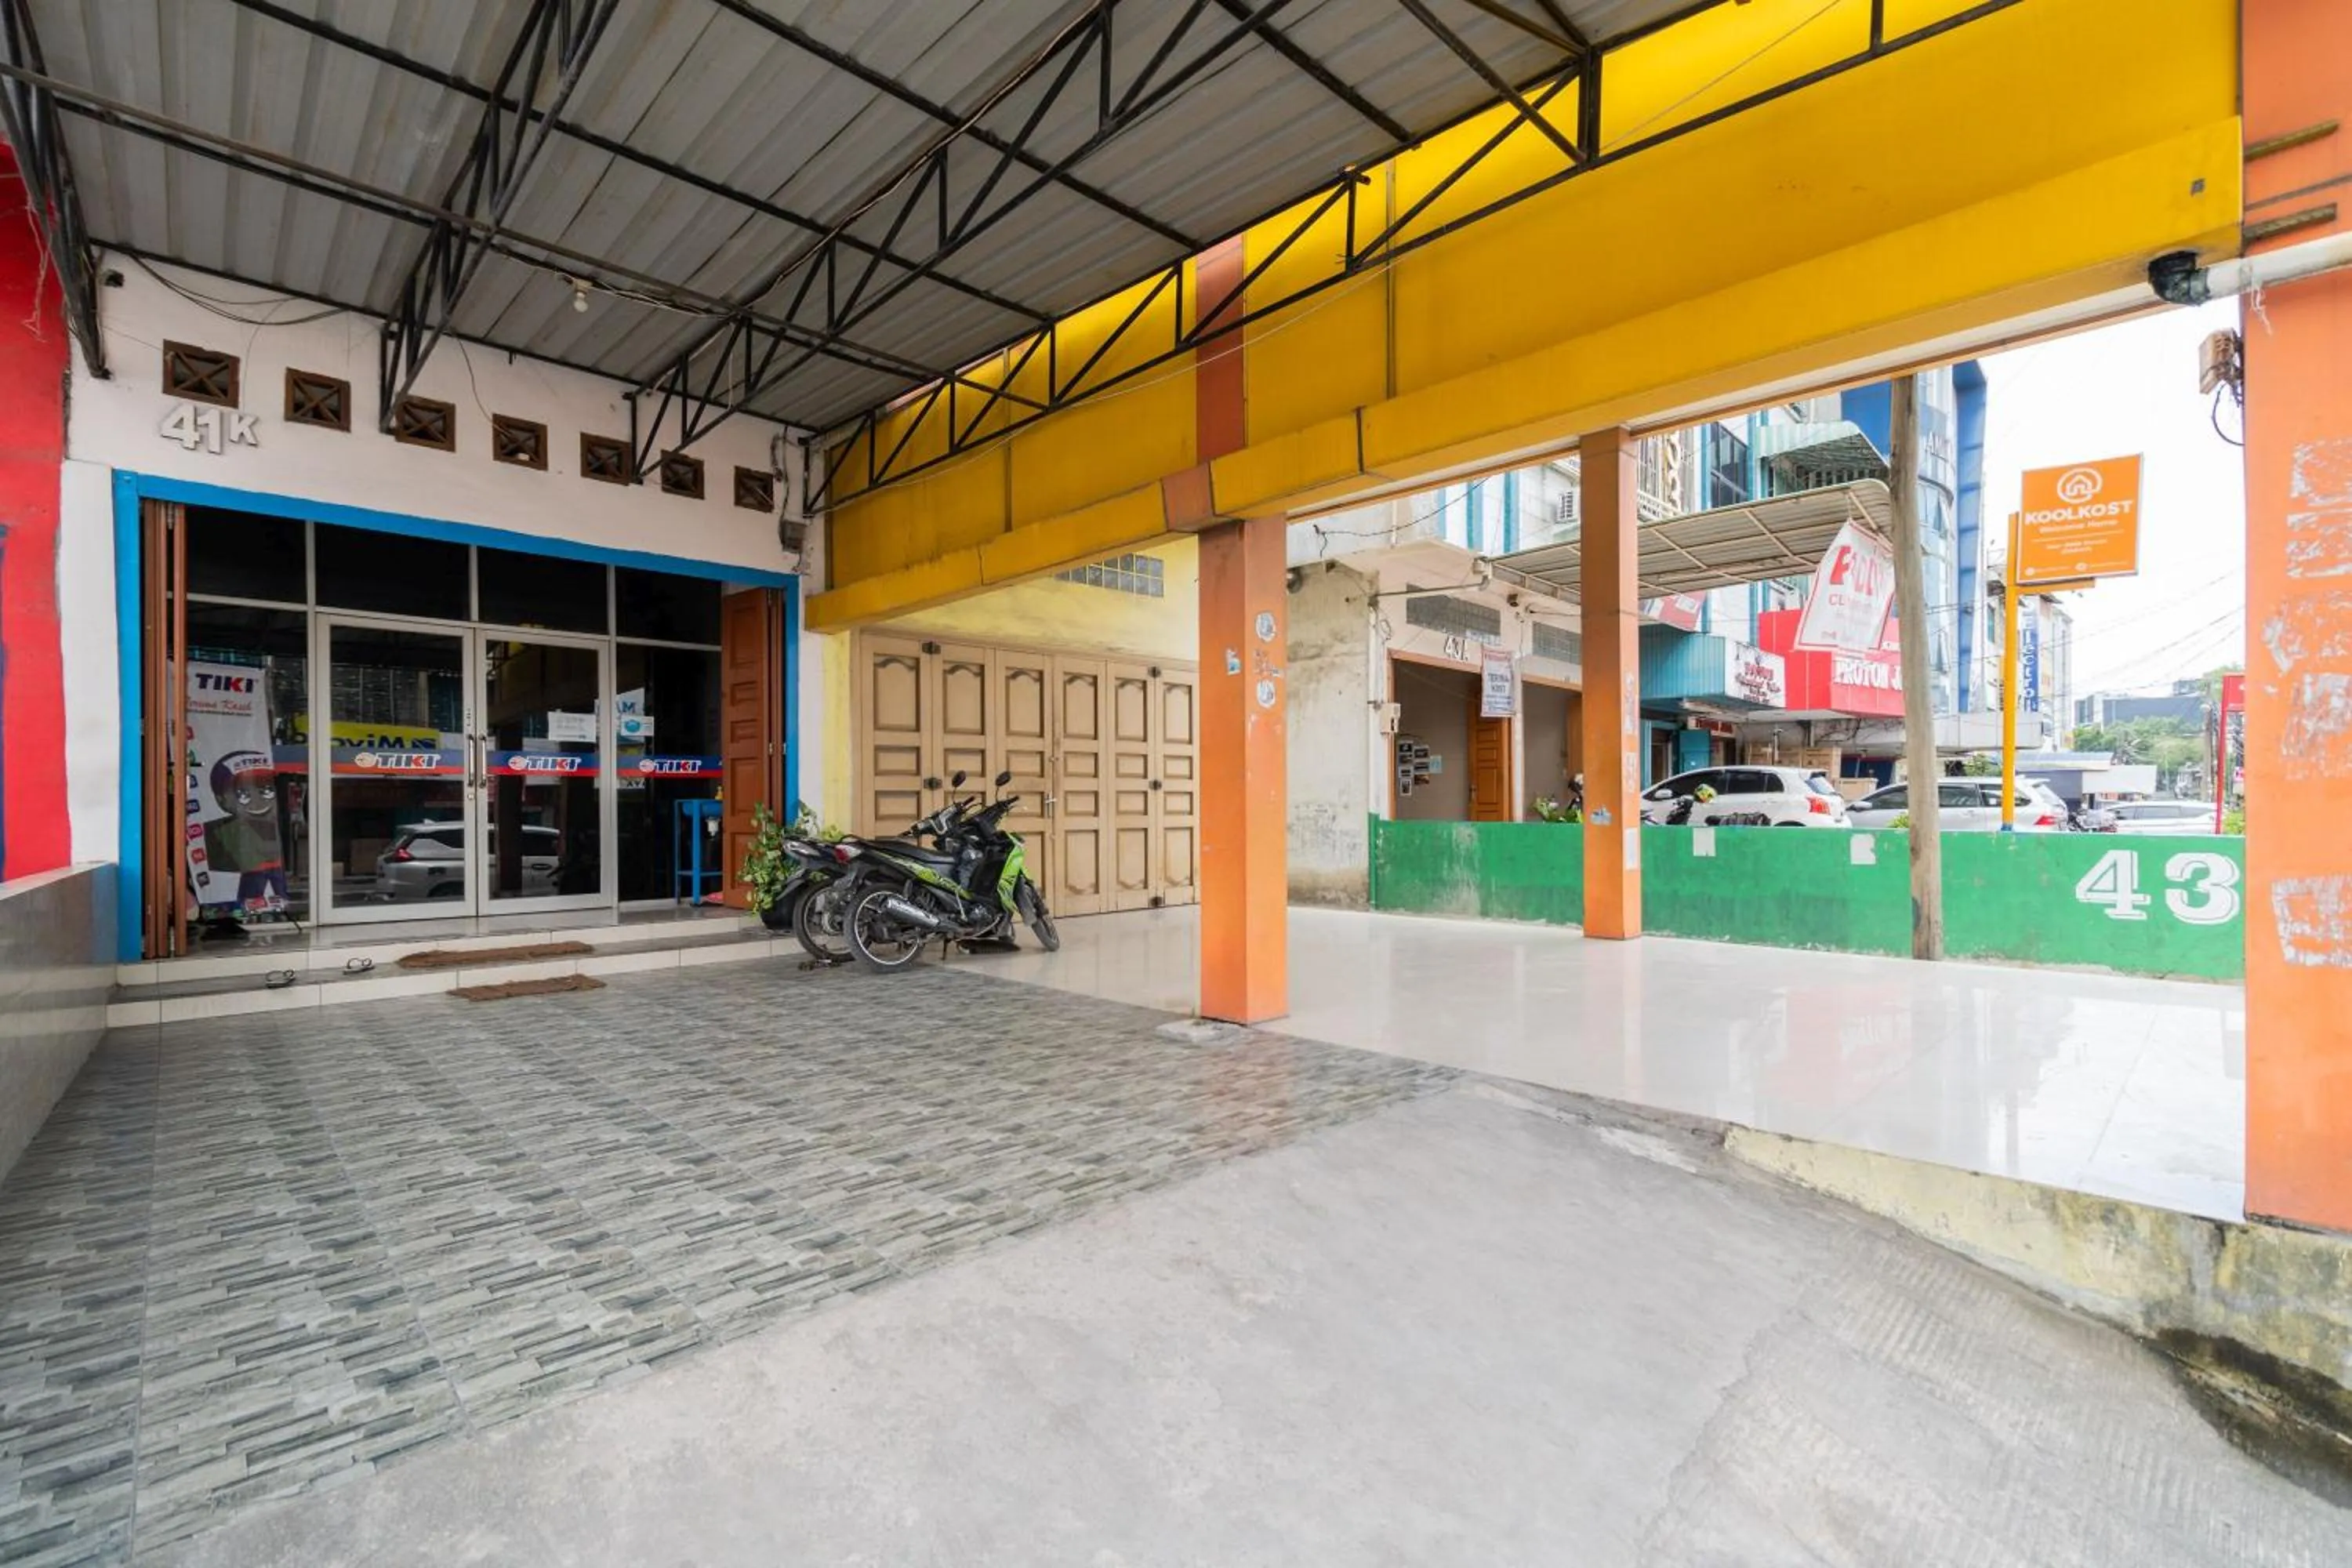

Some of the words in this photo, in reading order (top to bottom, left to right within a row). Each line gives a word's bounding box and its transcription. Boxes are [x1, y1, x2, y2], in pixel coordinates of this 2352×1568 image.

[161, 403, 259, 455] 41K
[2024, 500, 2133, 524] KOOLKOST
[195, 673, 253, 694] TIKI
[376, 753, 441, 769] TIKI
[526, 757, 582, 771] TIKI
[654, 760, 702, 775] TIKI
[2075, 849, 2241, 925] 43
